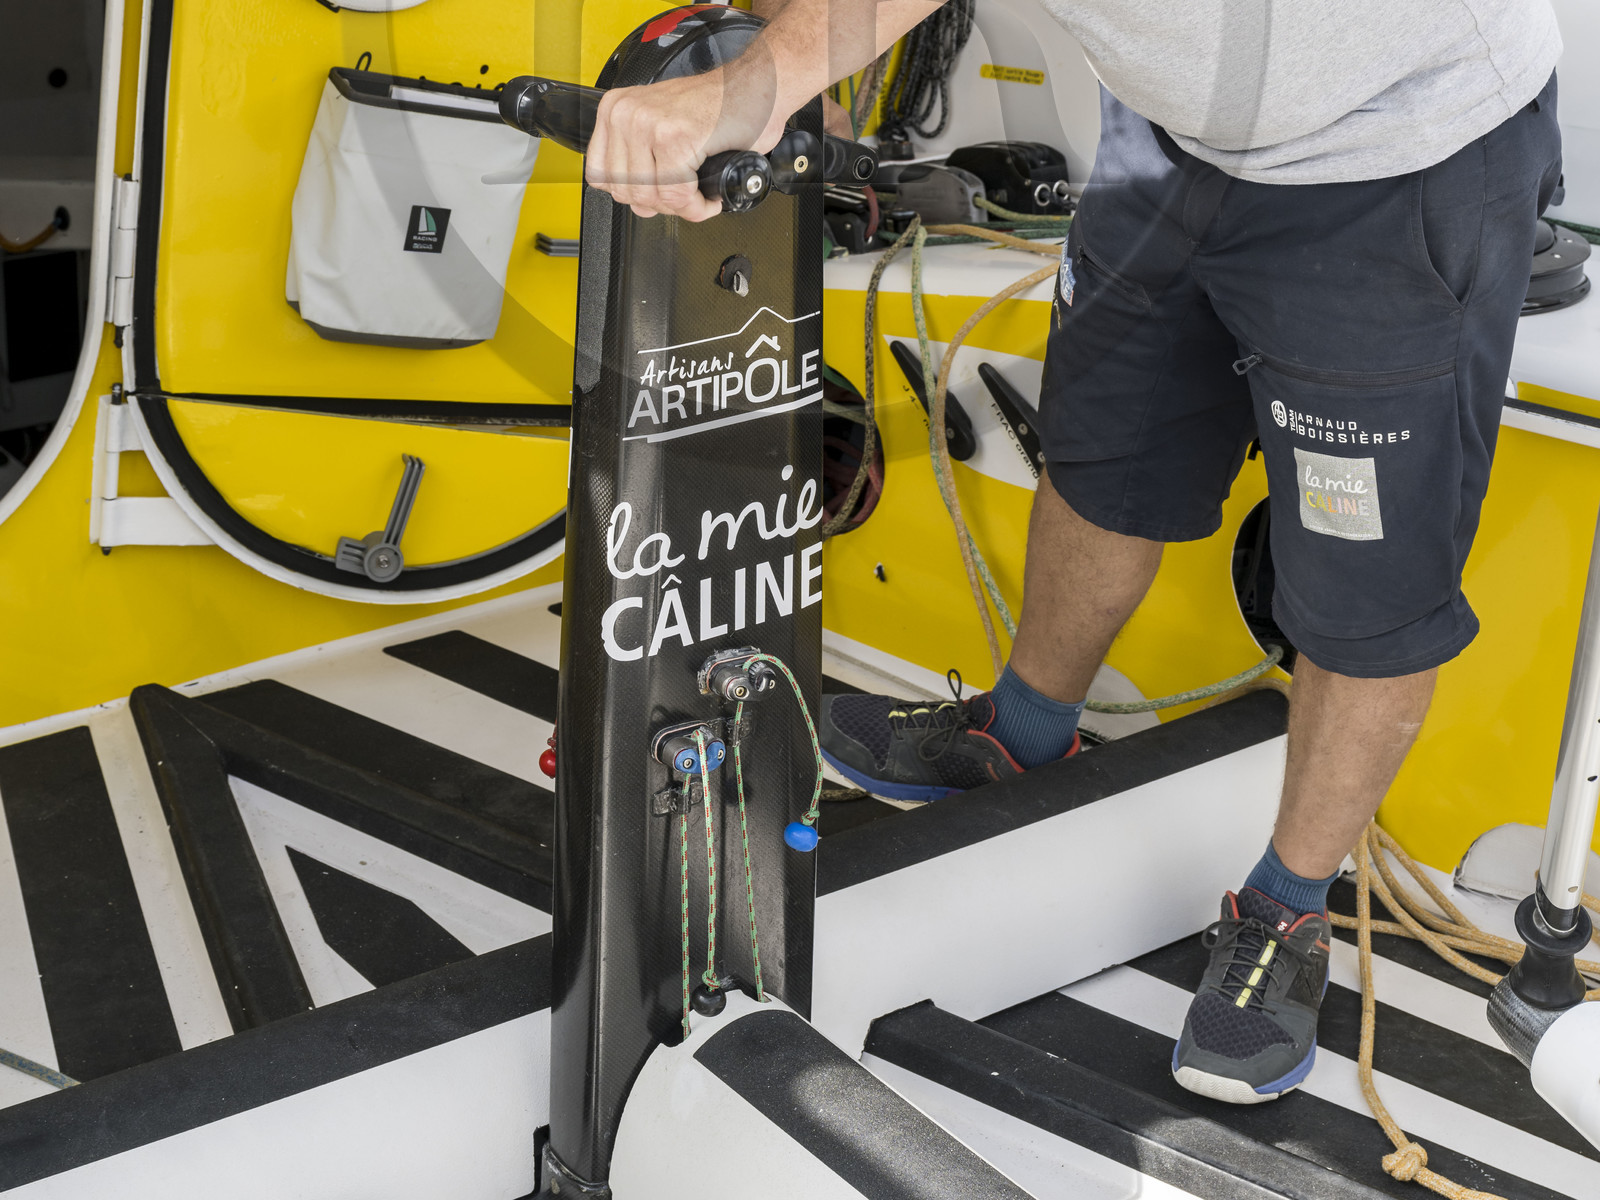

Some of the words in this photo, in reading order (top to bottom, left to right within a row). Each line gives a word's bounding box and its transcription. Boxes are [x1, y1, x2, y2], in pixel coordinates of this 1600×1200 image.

[639, 350, 735, 388] Artisans
[1297, 412, 1357, 431] ARNAUD
[1298, 424, 1410, 444] BOISSIÈRES
[1305, 465, 1323, 489] la
[1325, 474, 1369, 494] mie
[606, 501, 686, 580] la
[698, 464, 823, 560] mie
[601, 541, 823, 662] CÂLINE
